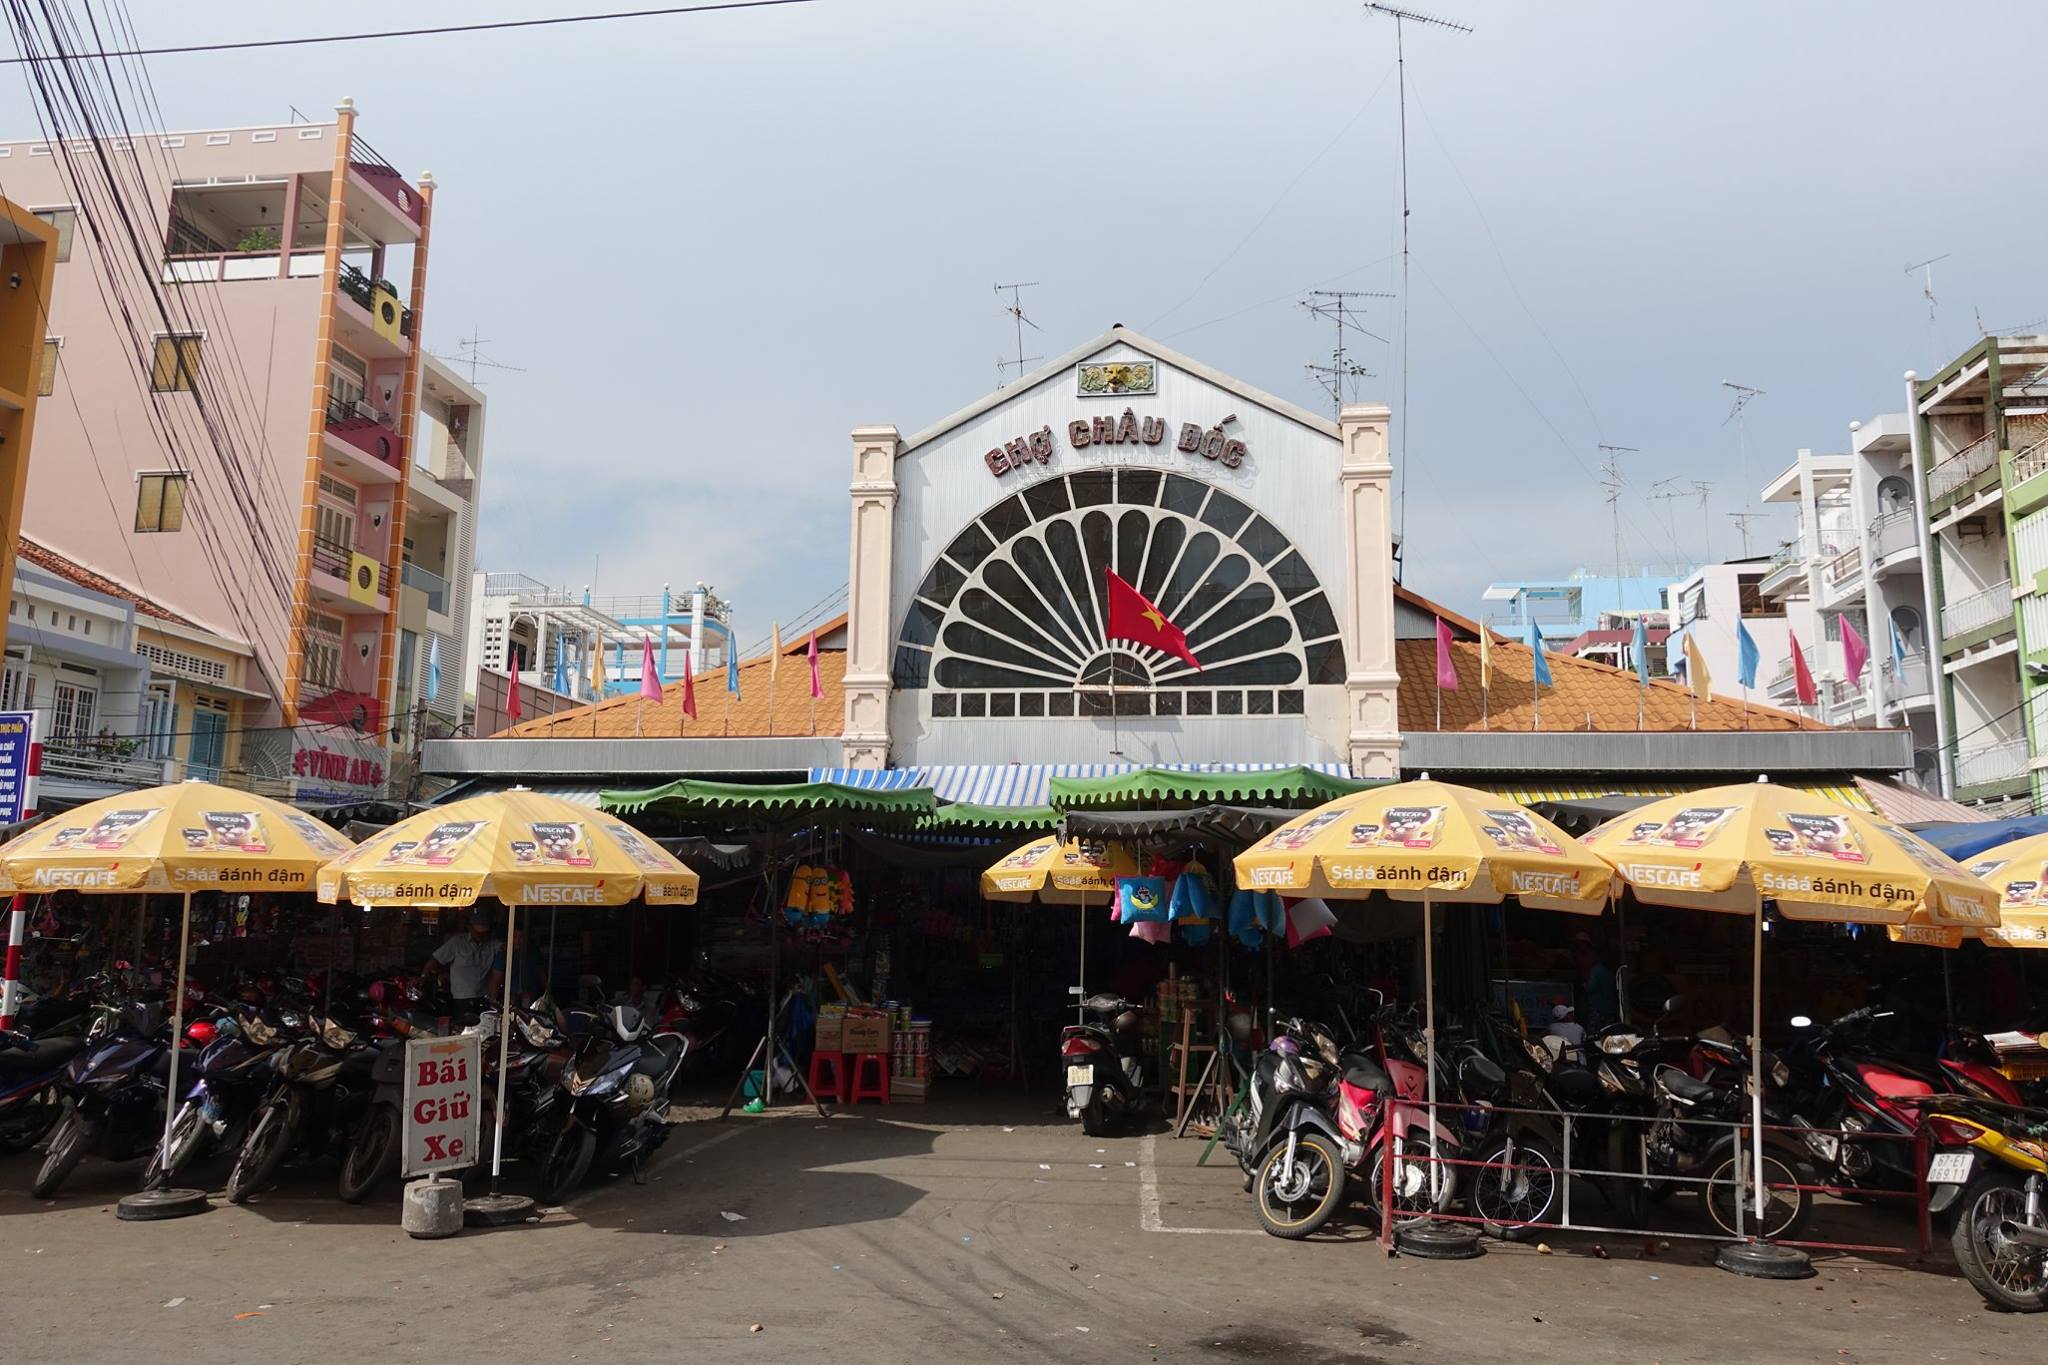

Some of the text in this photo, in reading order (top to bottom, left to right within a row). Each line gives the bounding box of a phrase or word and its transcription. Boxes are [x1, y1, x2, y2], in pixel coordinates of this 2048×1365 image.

[983, 424, 1052, 477] CHỢ
[1068, 406, 1165, 449] CHÂU
[268, 868, 305, 884] đậm
[1427, 867, 1467, 882] đậm
[439, 883, 473, 901] đậm
[1869, 882, 1915, 903] đậm
[417, 1057, 468, 1087] Bãi
[413, 1090, 471, 1125] Giữ
[422, 1134, 464, 1162] Xe
